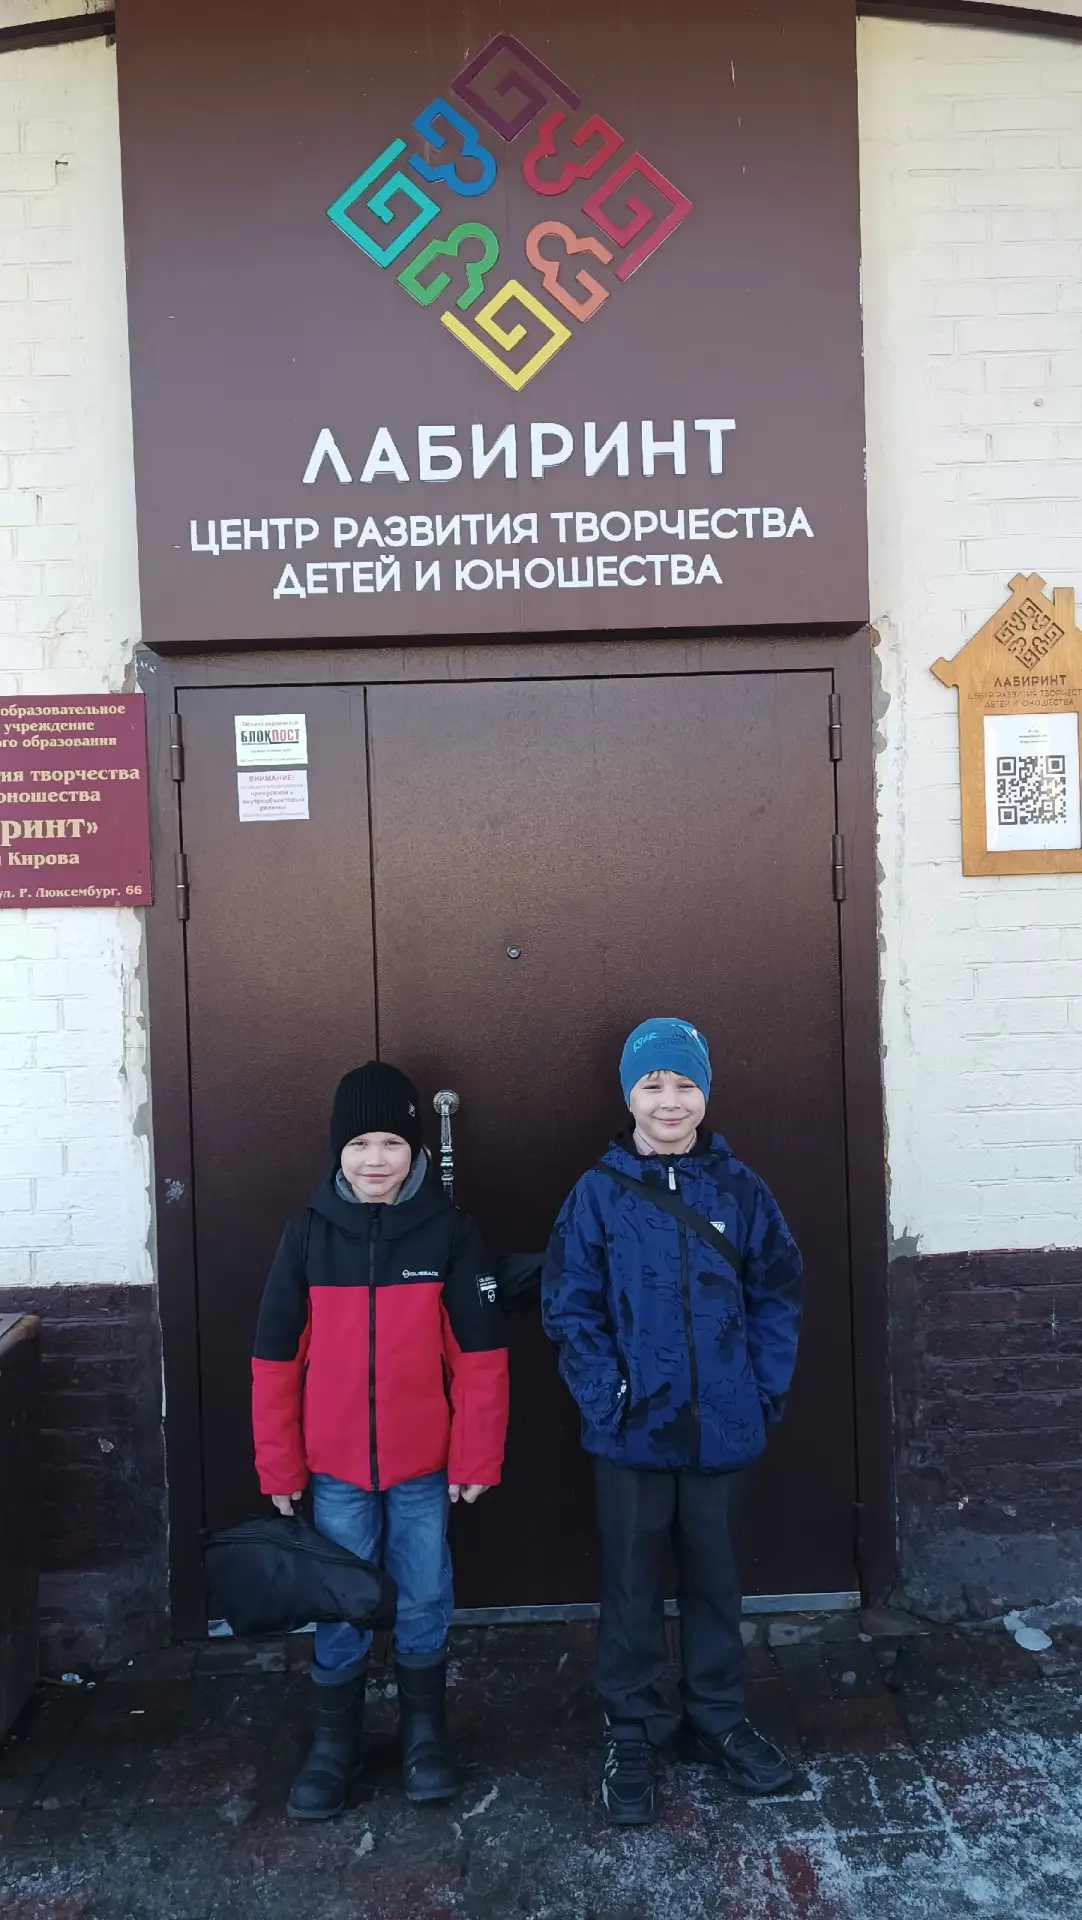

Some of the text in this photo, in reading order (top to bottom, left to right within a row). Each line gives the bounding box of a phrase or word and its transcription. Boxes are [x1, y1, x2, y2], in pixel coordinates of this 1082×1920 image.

[302, 418, 736, 484] ЛАБИРИНТ
[190, 507, 815, 556] ЦЕНТР РАЗВИТИЯ ТВОРЧЕСТВА
[273, 553, 724, 600] ДЕТЕЙ И ЮНОШЕСТВА
[993, 674, 1067, 688] ЛАБИРИНТ
[0, 704, 126, 718] образовательное
[3, 720, 95, 735] учреждение
[22, 735, 117, 750] образования
[241, 729, 301, 744] БЛОКПОСТ
[0, 768, 141, 785] ия творчества
[8, 852, 80, 869] Кирова
[125, 885, 142, 895] 66
